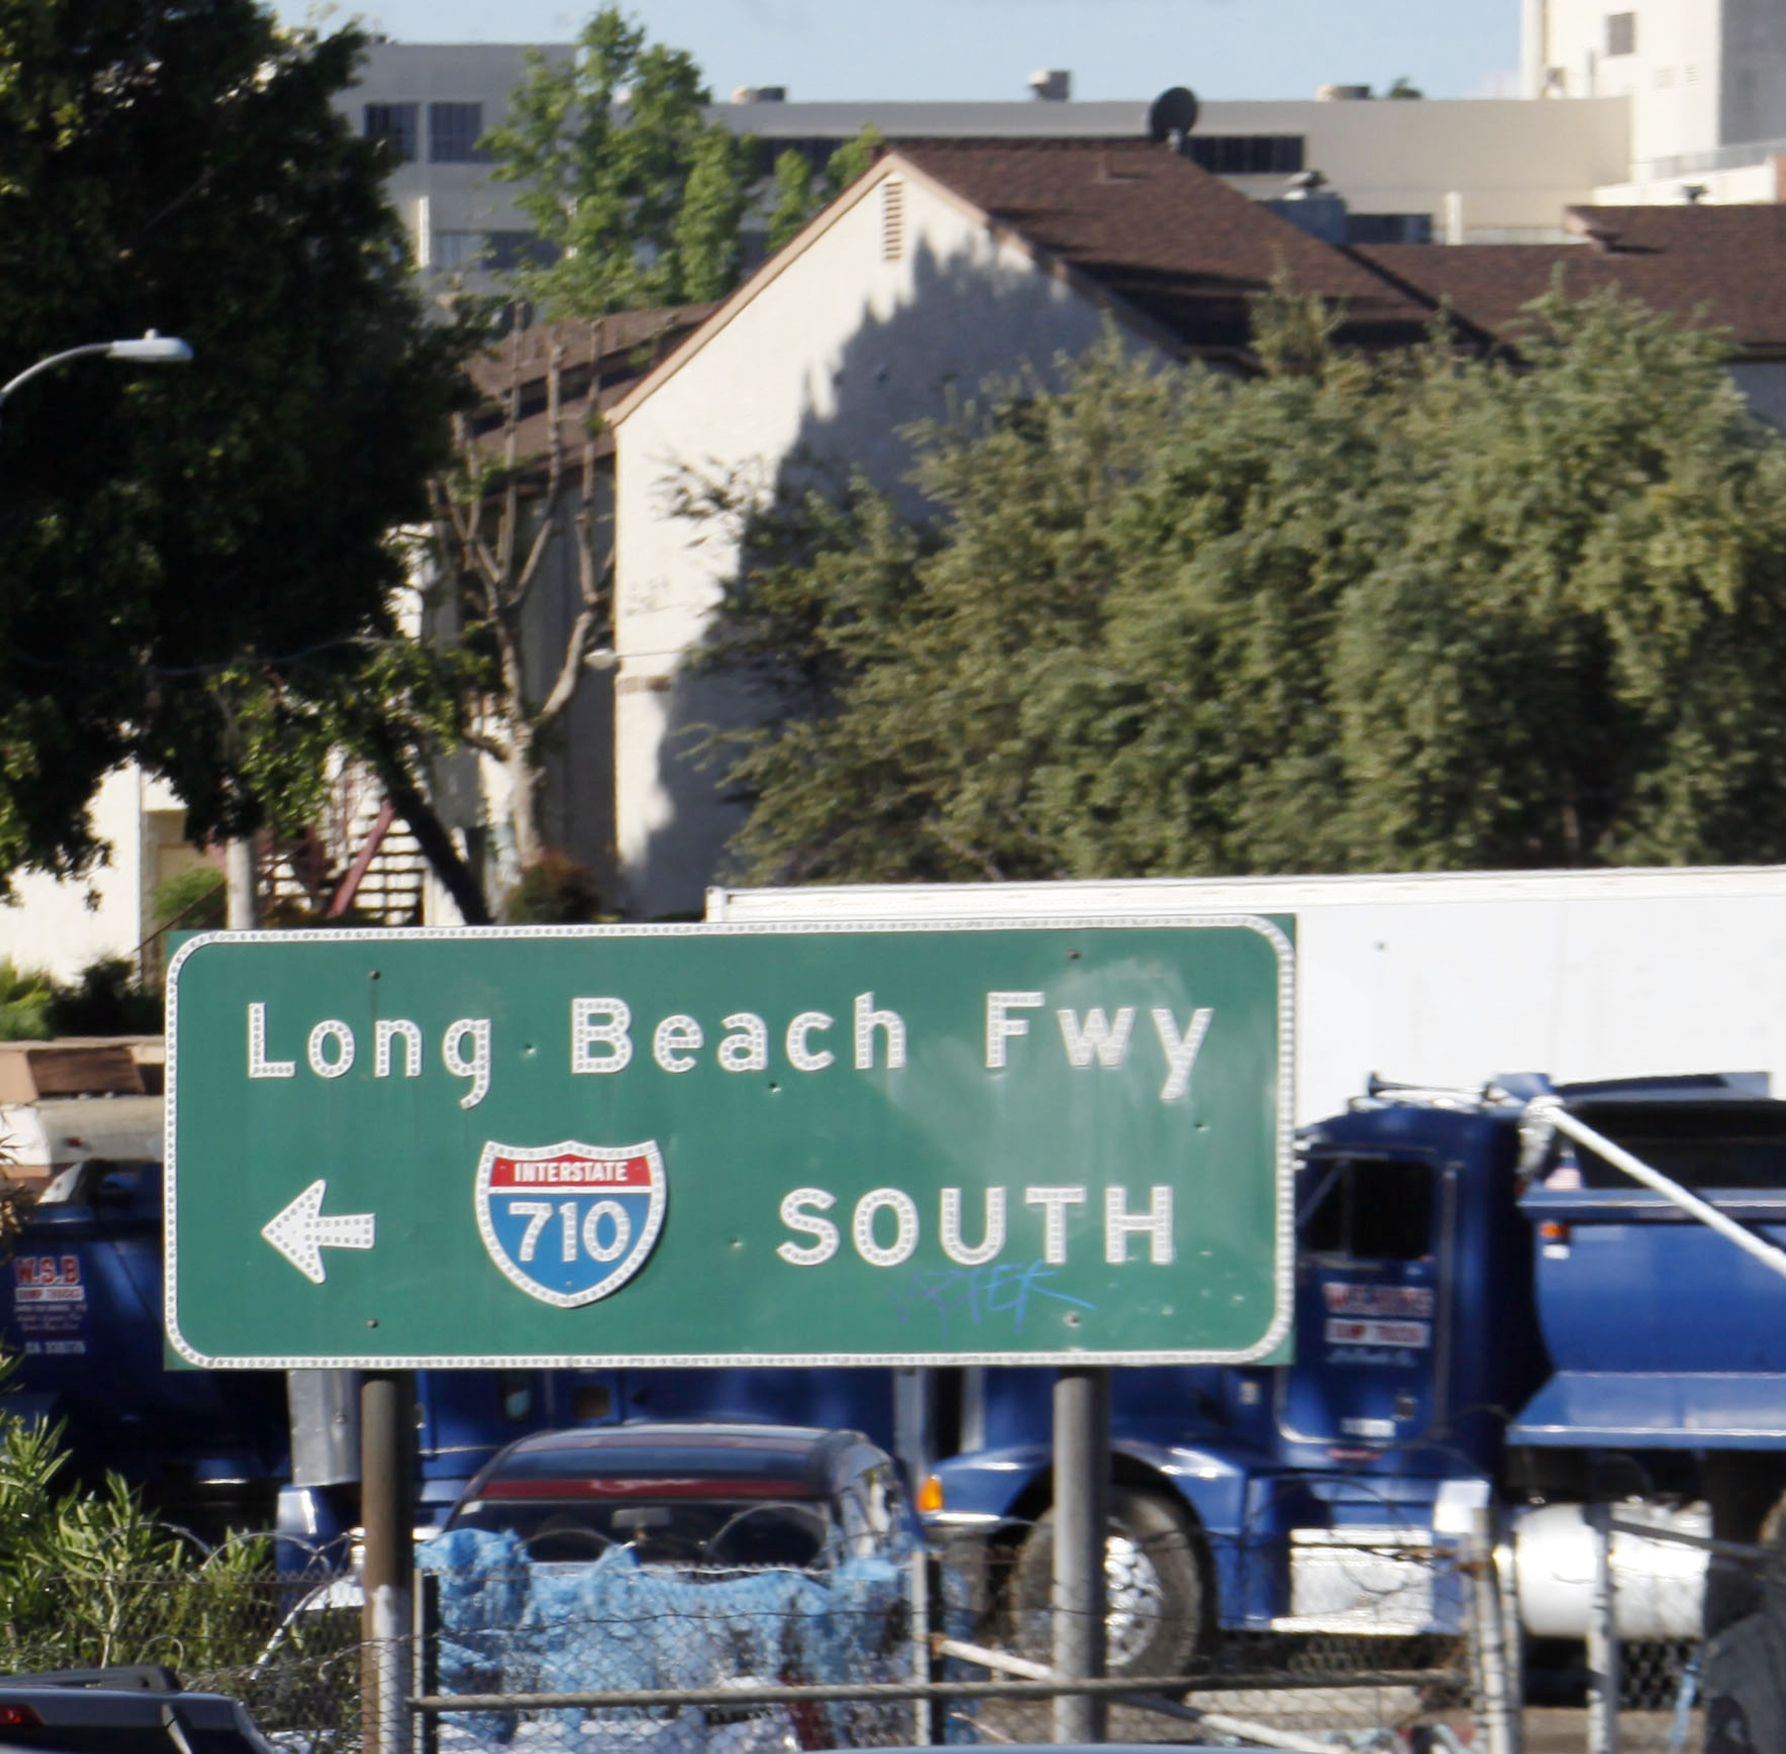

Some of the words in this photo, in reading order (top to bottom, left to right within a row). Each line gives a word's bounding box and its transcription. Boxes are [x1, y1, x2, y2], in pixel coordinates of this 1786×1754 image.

[248, 1003, 491, 1109] Long
[571, 991, 906, 1074] Beach
[986, 991, 1214, 1102] Fwy
[514, 1162, 629, 1182] INTERSTATE
[508, 1201, 631, 1262] 710
[776, 1186, 1175, 1267] SOUTH
